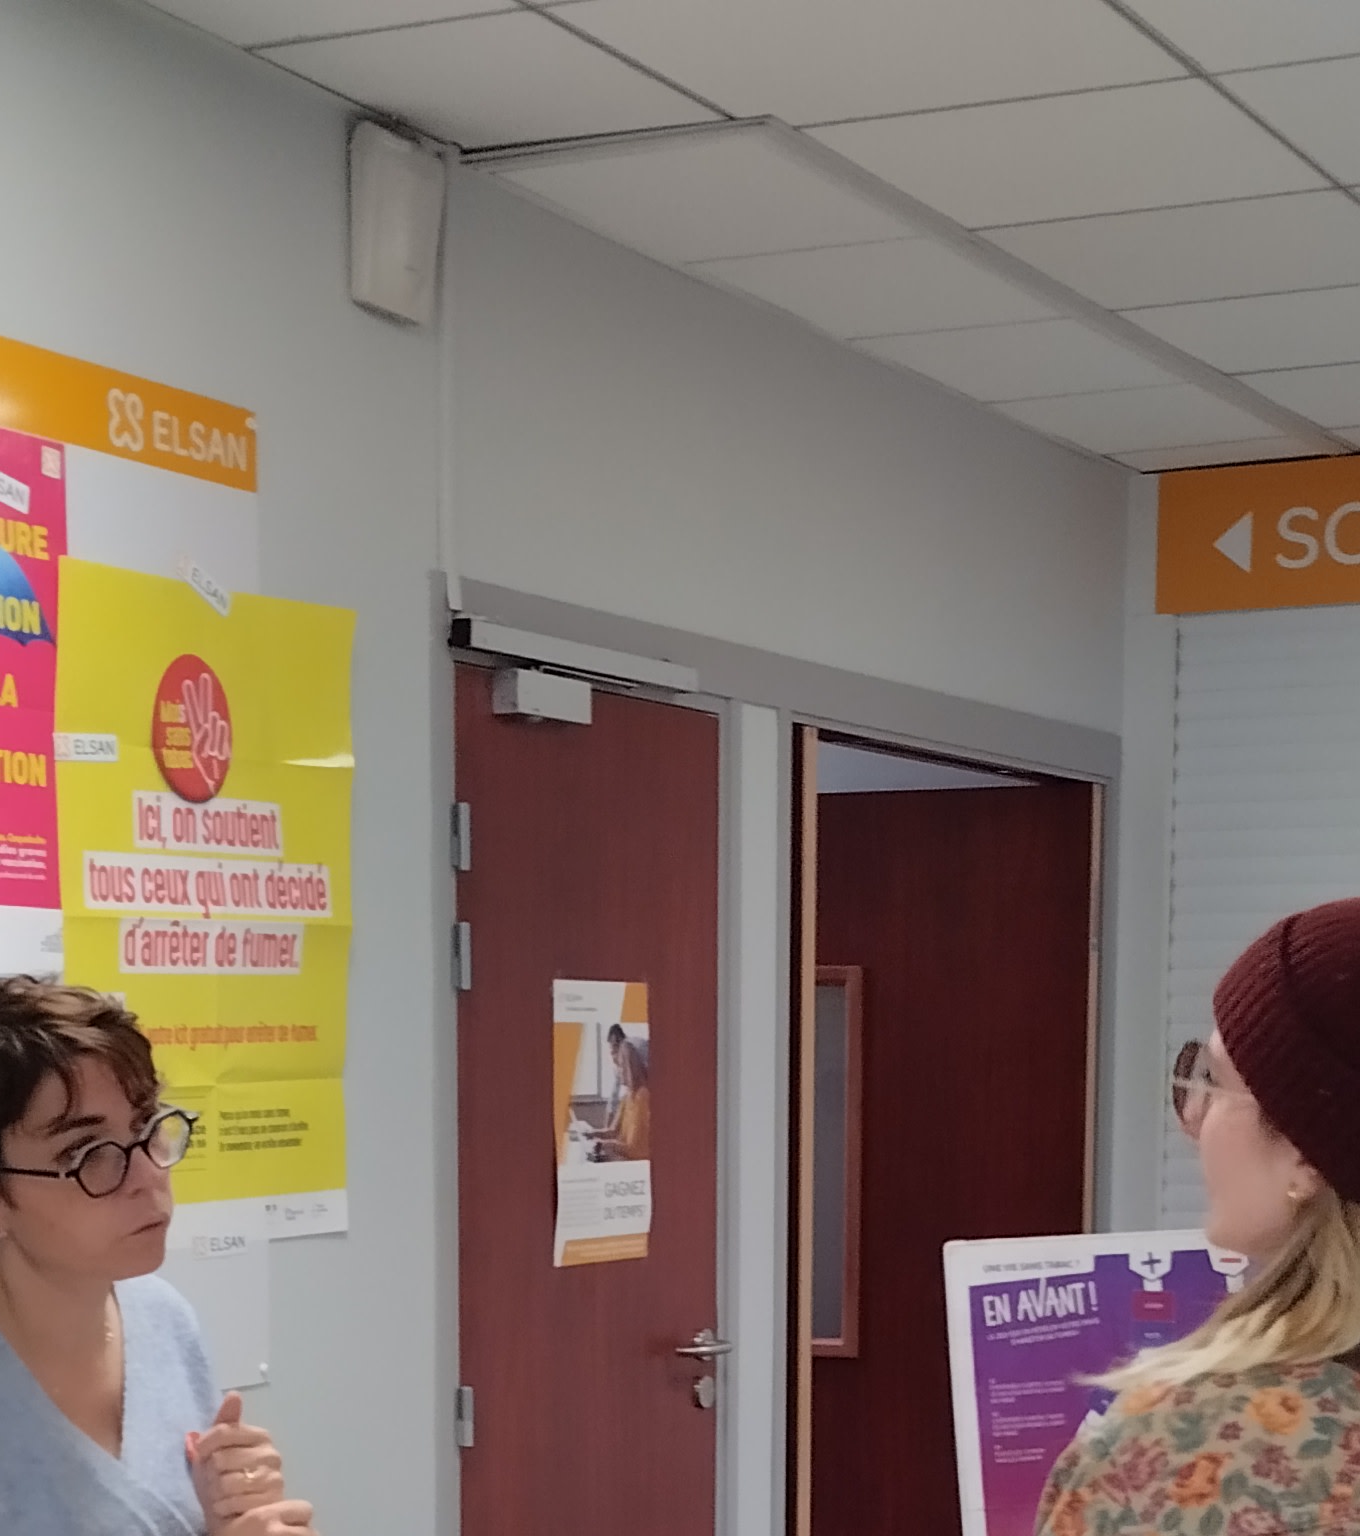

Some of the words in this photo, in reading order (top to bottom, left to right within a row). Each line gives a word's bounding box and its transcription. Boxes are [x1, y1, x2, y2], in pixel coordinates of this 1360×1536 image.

[153, 410, 248, 471] ELSAN
[191, 567, 229, 609] ELSAN
[74, 738, 116, 756] ELSAN
[137, 794, 167, 849] Ici,
[173, 806, 197, 845] on
[201, 802, 280, 850] soutient
[89, 858, 136, 903] tous
[141, 867, 189, 907] ceux
[195, 863, 227, 919] qui
[231, 866, 262, 909] ont
[265, 858, 328, 911] décidé
[124, 917, 210, 968] d'arrêter
[214, 926, 237, 968] de
[210, 1236, 246, 1253] ELSAN
[983, 1292, 1012, 1327] EN
[1016, 1281, 1086, 1323] AVANT
[1088, 1280, 1099, 1312] !
